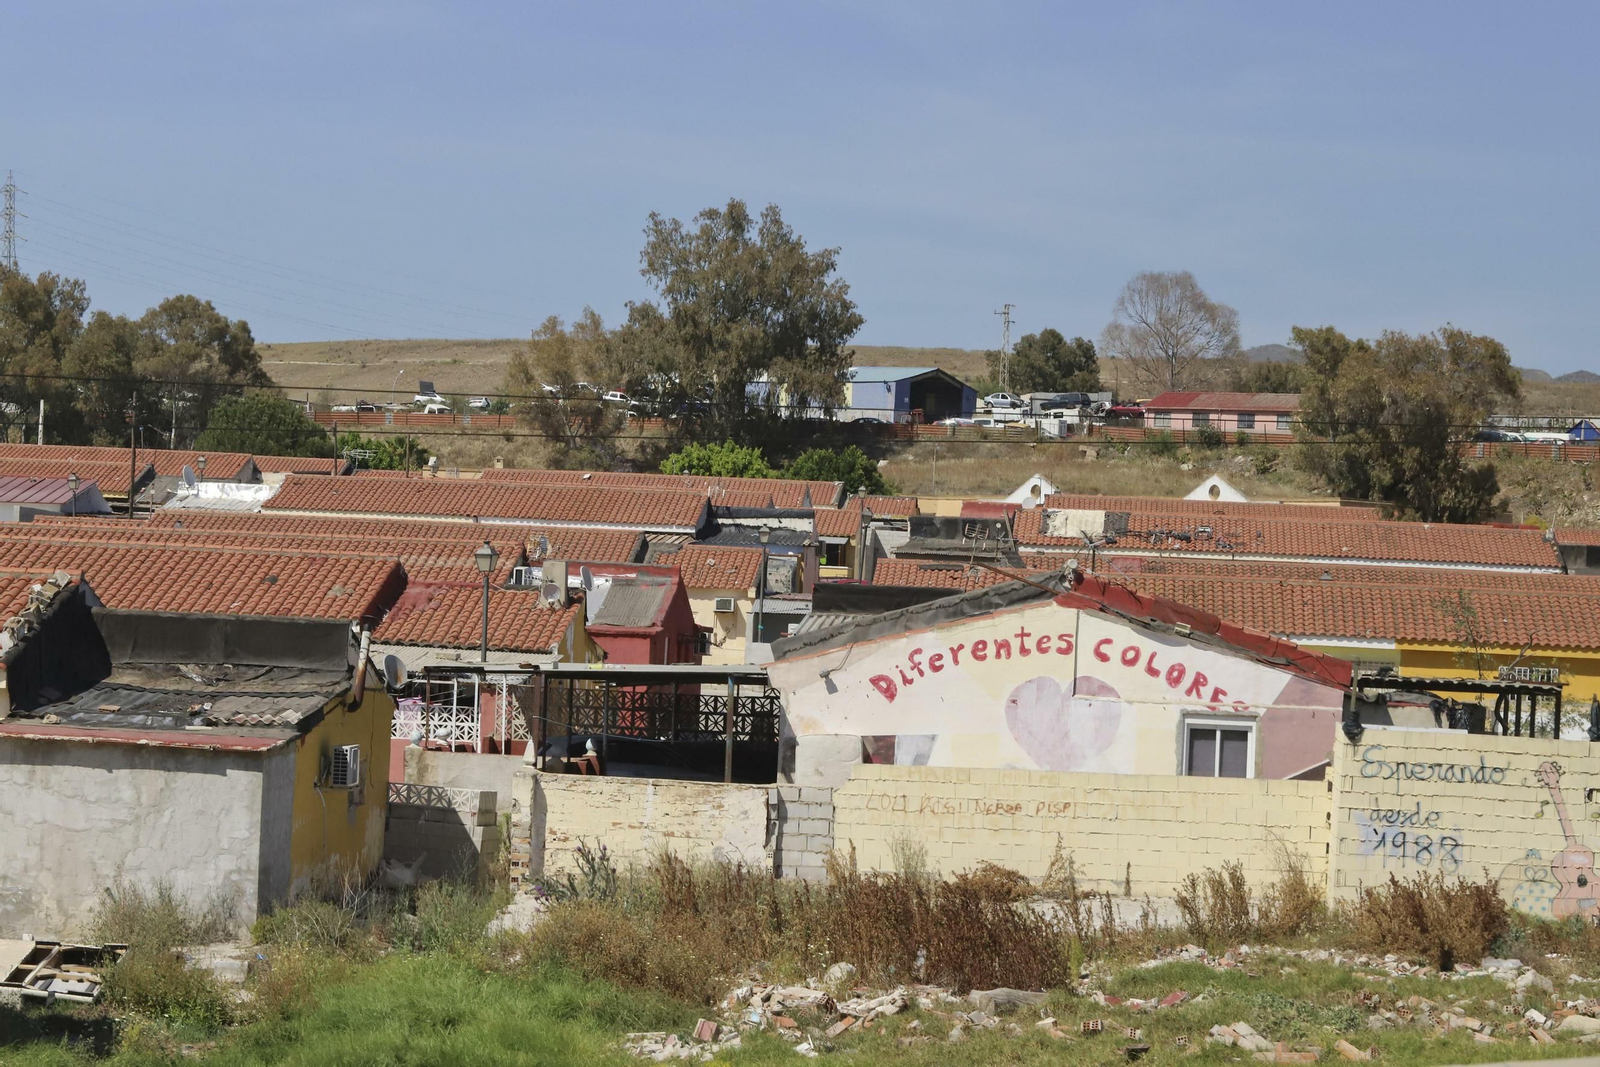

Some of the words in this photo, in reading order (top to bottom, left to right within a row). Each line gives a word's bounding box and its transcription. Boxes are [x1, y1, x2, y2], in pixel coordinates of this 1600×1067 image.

[868, 626, 1074, 704] Diferentes
[1360, 745, 1510, 795] Esperando
[1369, 797, 1441, 828] desde
[1372, 831, 1460, 874] 1988
